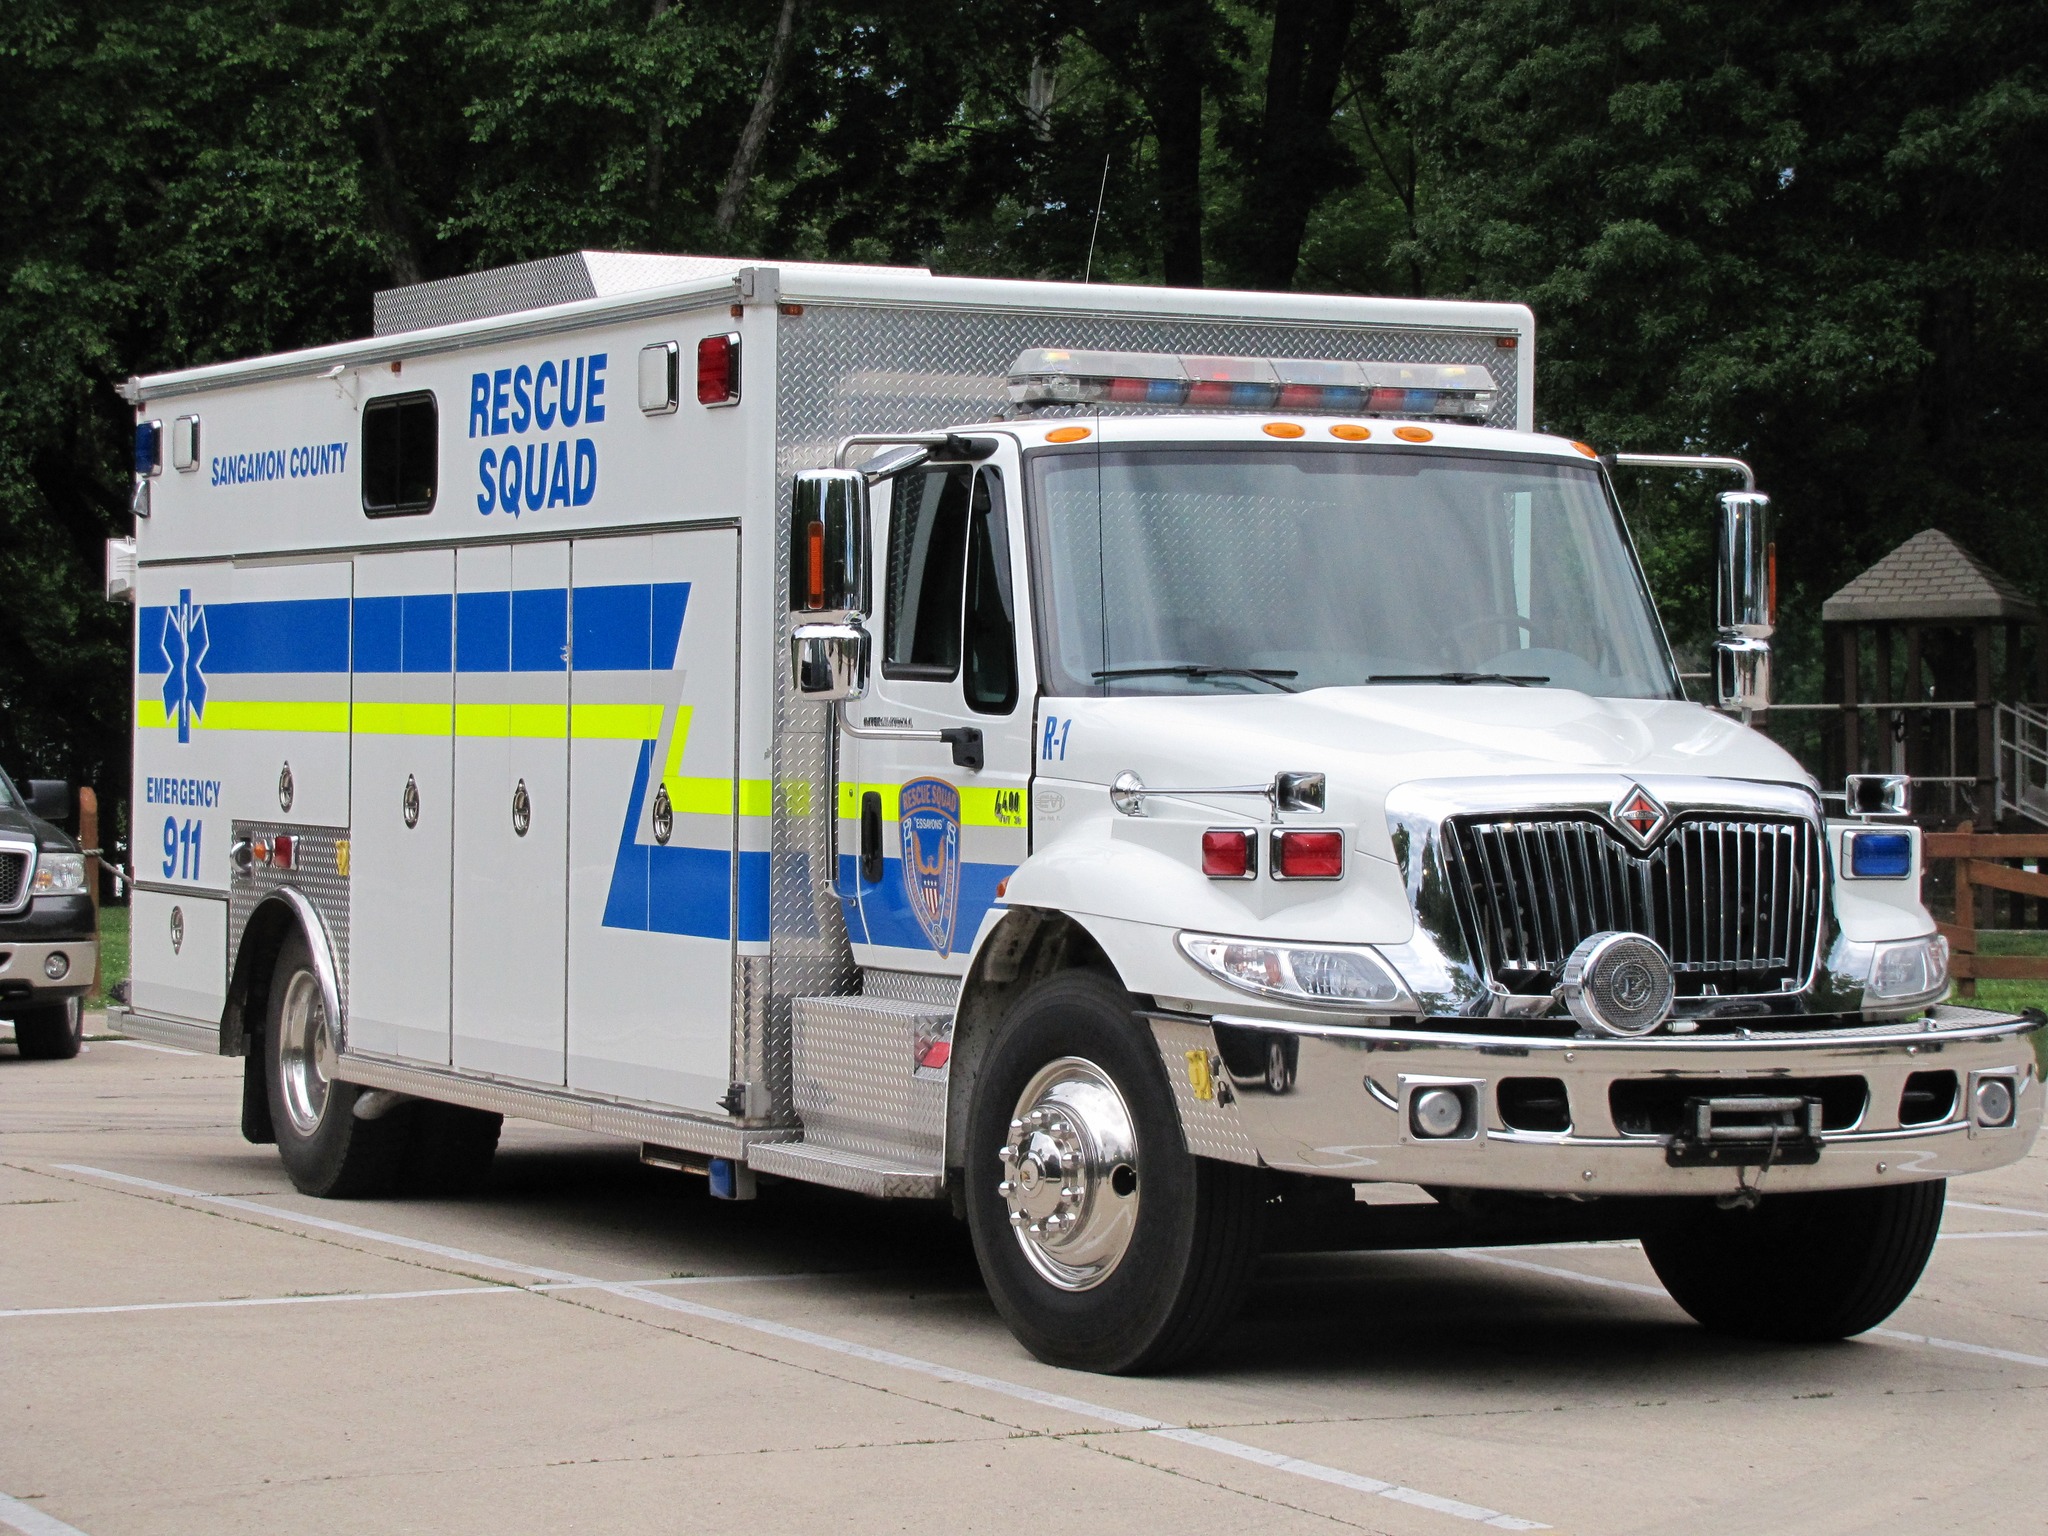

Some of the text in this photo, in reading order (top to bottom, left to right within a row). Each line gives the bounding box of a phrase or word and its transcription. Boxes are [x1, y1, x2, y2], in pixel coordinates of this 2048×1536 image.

[469, 353, 608, 439] RESCUE
[211, 442, 348, 487] SANGAMON COUNTY
[476, 437, 598, 520] SQUAD
[1042, 716, 1072, 761] R-1
[147, 777, 221, 808] EMERGENCY
[902, 784, 957, 812] RESCUE SQUAD
[163, 815, 202, 881] 911
